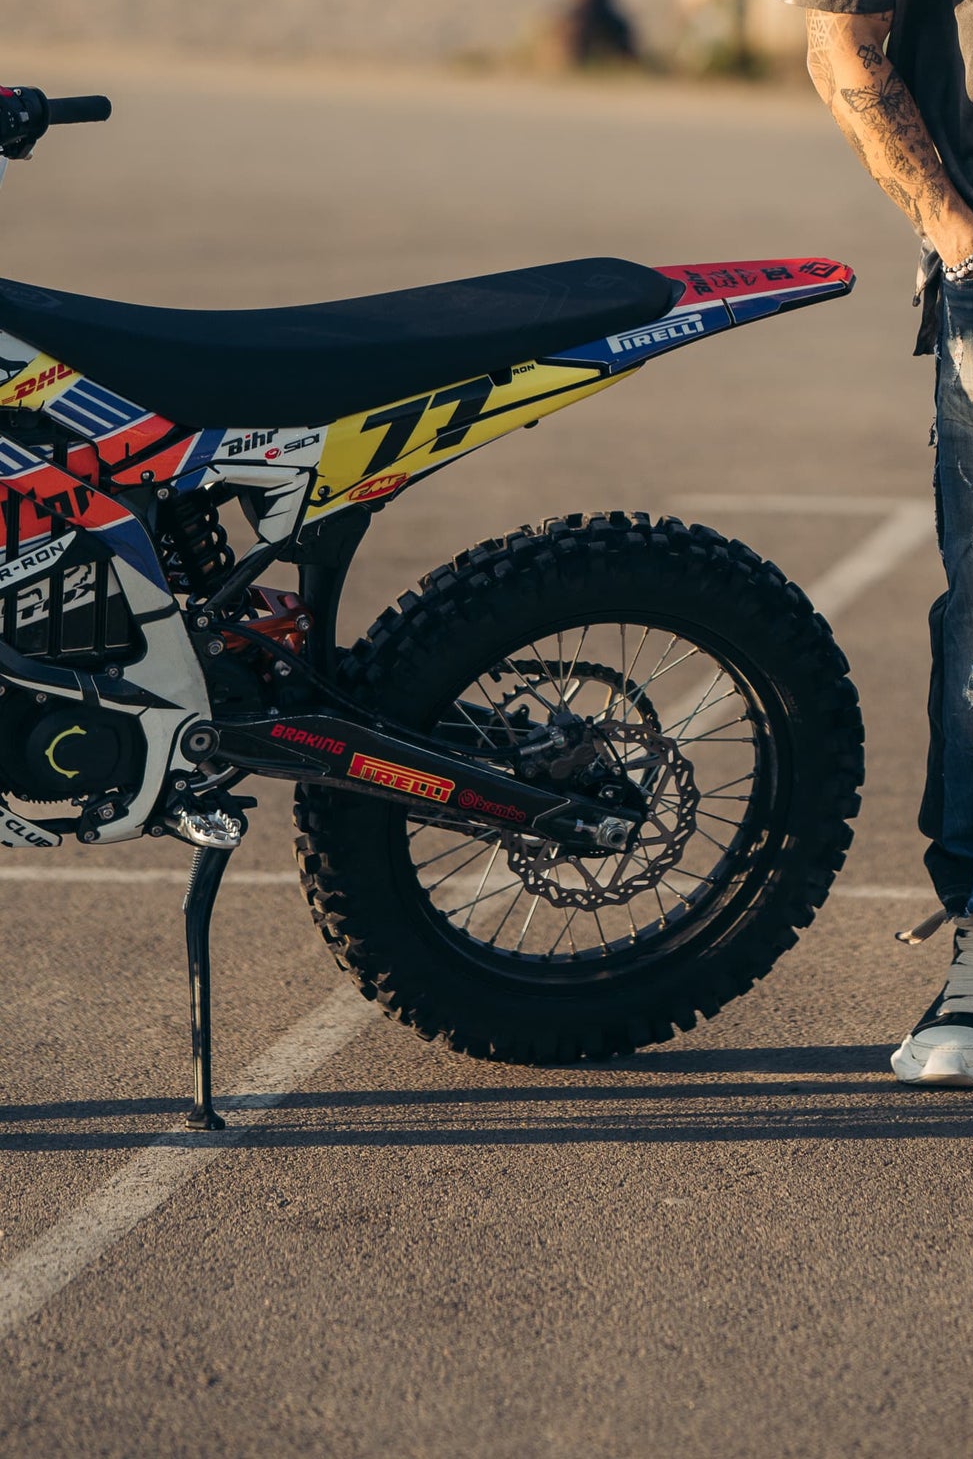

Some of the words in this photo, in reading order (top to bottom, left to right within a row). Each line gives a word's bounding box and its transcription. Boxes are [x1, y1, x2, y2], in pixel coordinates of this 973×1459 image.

[606, 313, 704, 354] PIRELLI
[221, 428, 279, 457] Bihr
[360, 374, 494, 478] 77
[351, 474, 406, 499] FMF
[270, 723, 347, 756] BRAKING
[347, 752, 456, 804] PIRELLI
